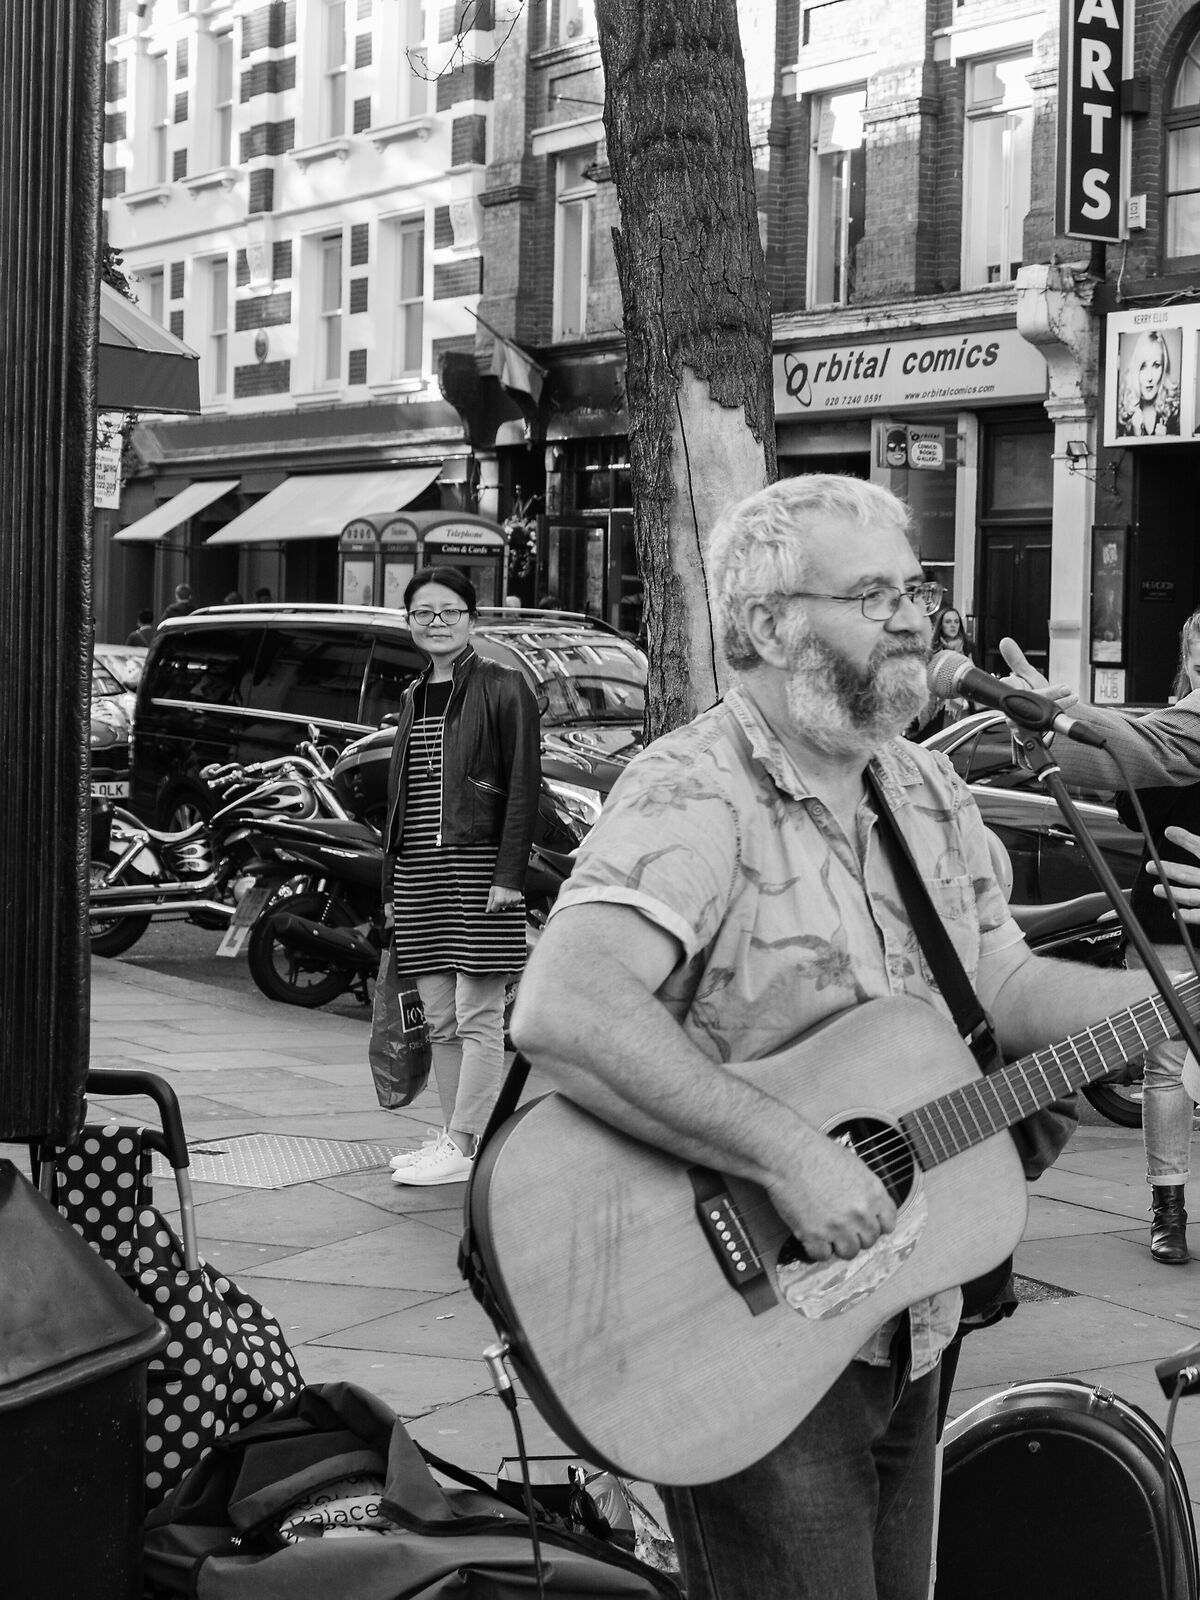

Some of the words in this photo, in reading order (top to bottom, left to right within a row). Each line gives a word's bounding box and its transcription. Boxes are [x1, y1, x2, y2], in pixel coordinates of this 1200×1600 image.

[1077, 0, 1120, 220] ARTS
[1133, 315, 1151, 325] KERRY
[1153, 312, 1168, 322] ELLIS
[902, 339, 1000, 375] comics
[825, 396, 840, 406] 020
[841, 395, 862, 405] 7240
[864, 394, 882, 403] 0591
[904, 384, 995, 400] www.orbitalcomics.com
[446, 529, 483, 540] Telephone
